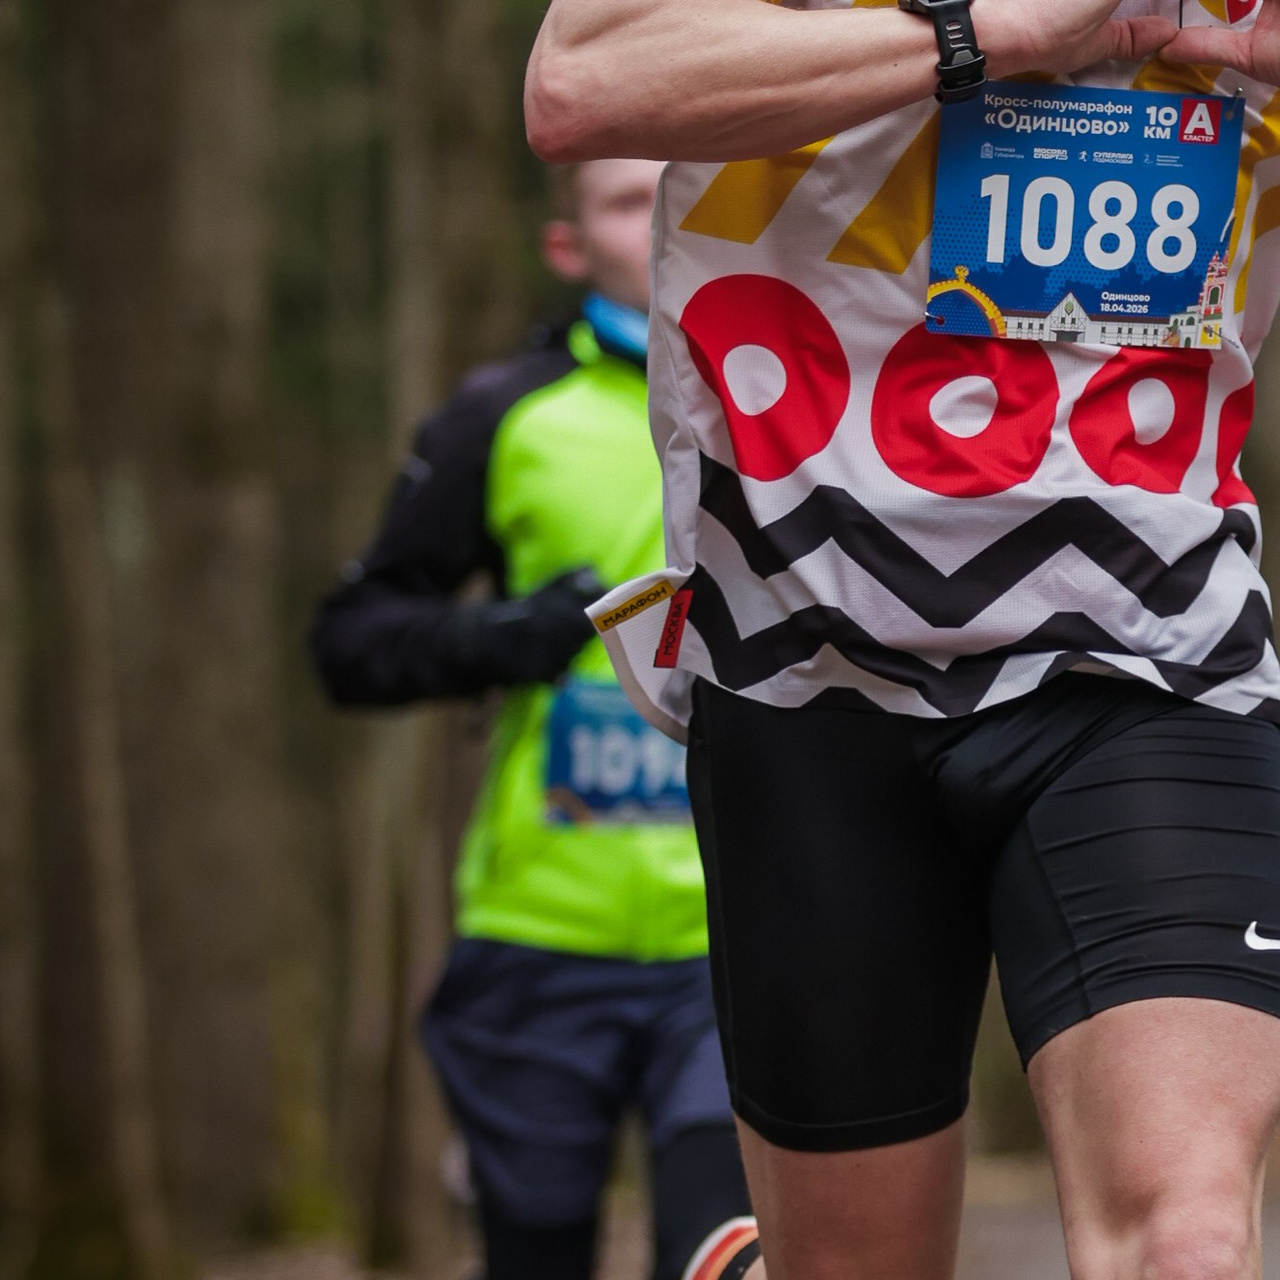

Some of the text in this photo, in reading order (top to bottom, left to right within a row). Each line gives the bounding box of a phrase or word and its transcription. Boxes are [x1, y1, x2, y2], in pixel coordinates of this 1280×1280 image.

[984, 93, 1133, 114] Кросс-полумарафон
[984, 108, 1130, 136] «Одинцово»
[1146, 106, 1178, 126] 10
[1183, 134, 1214, 142] КЛАСТЕР
[980, 174, 1200, 274] 1088
[1100, 303, 1149, 313] 18.04.2026
[1101, 291, 1150, 302] Одинцово
[602, 586, 667, 627] МАРАФОН
[664, 601, 685, 656] МОСКВА
[569, 723, 688, 795] 109
